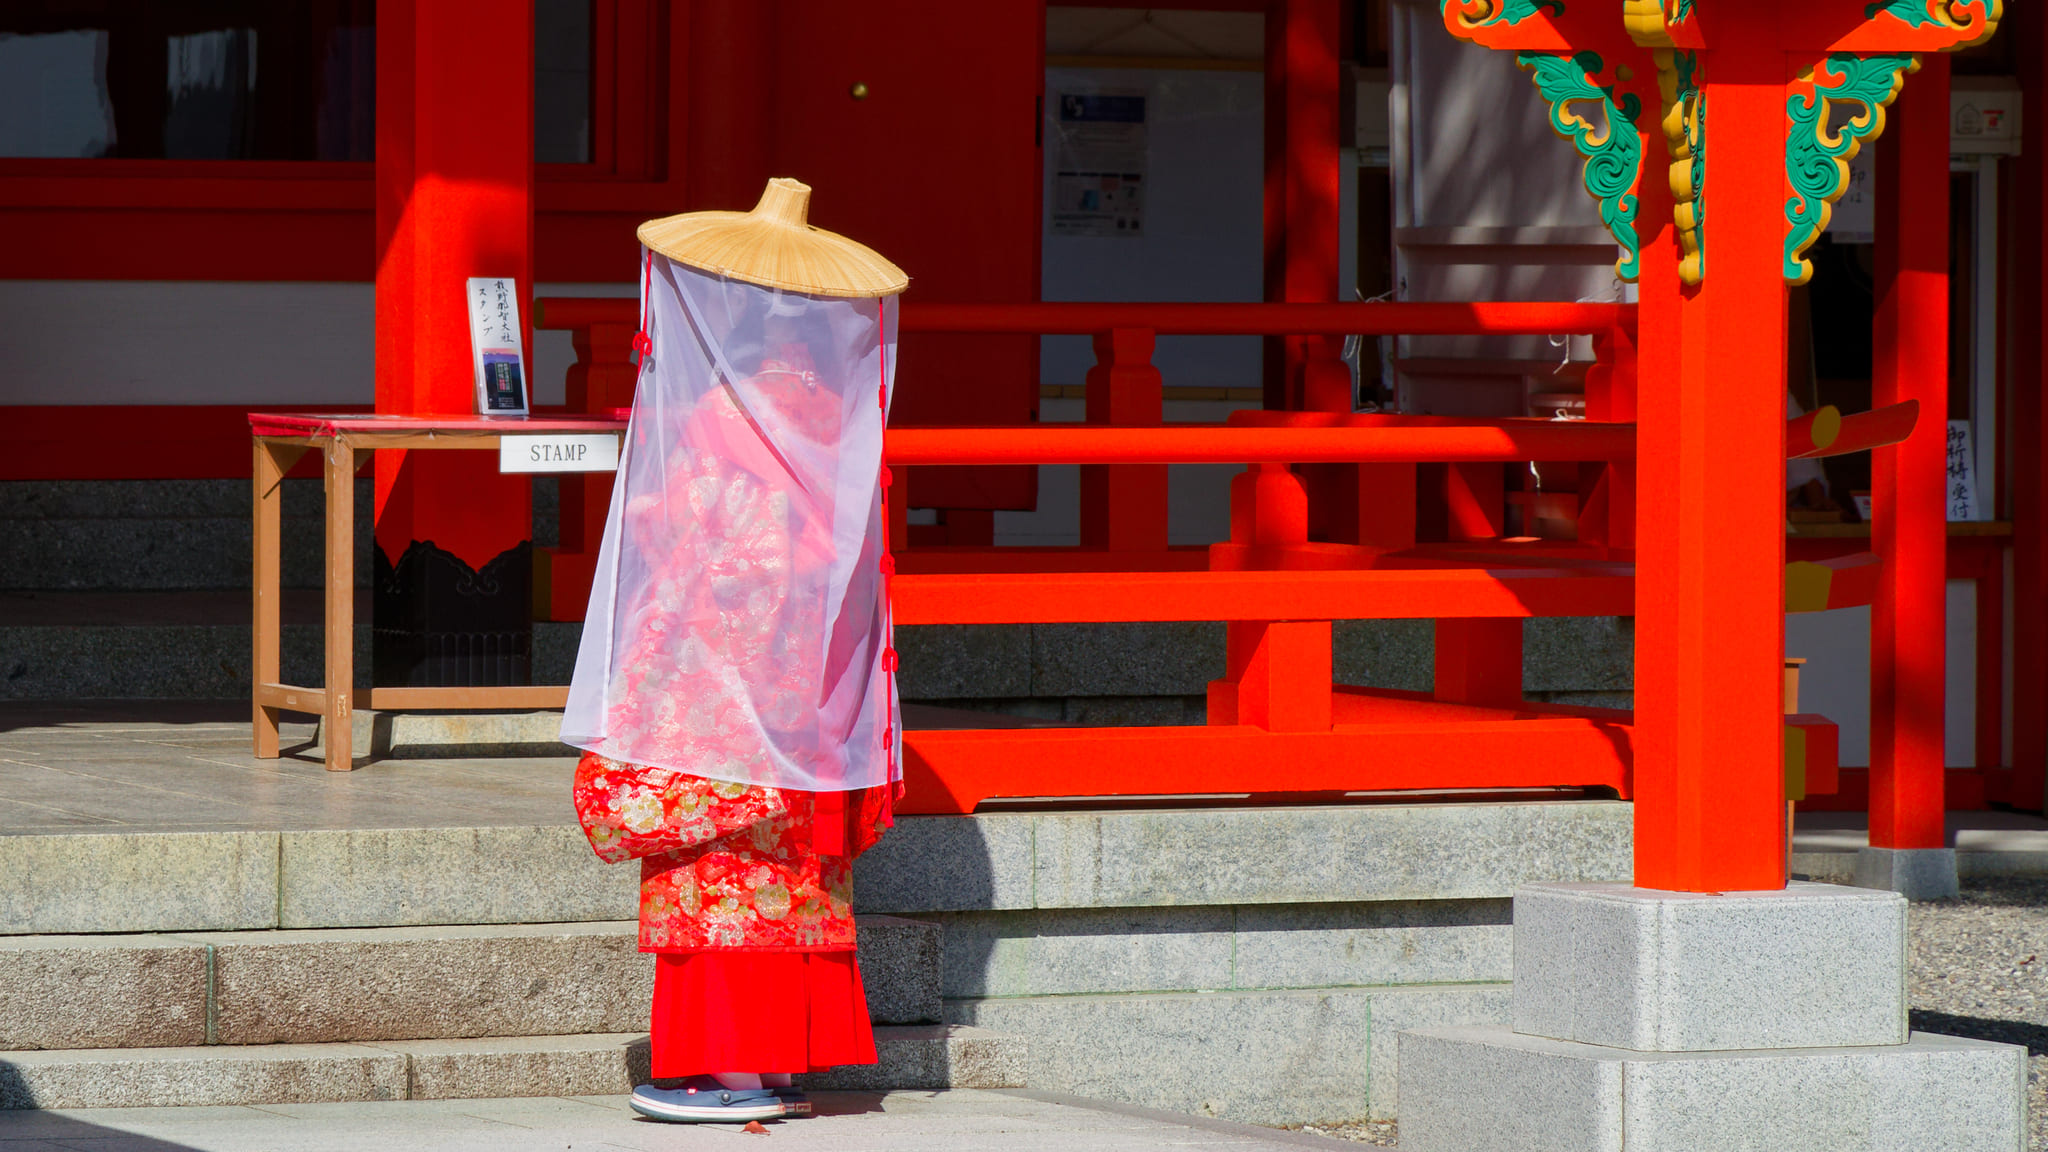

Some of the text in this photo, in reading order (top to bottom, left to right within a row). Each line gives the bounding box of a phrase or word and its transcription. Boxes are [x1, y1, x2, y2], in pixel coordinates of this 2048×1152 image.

[479, 288, 493, 337] スタンプ
[530, 444, 587, 462] STAMP
